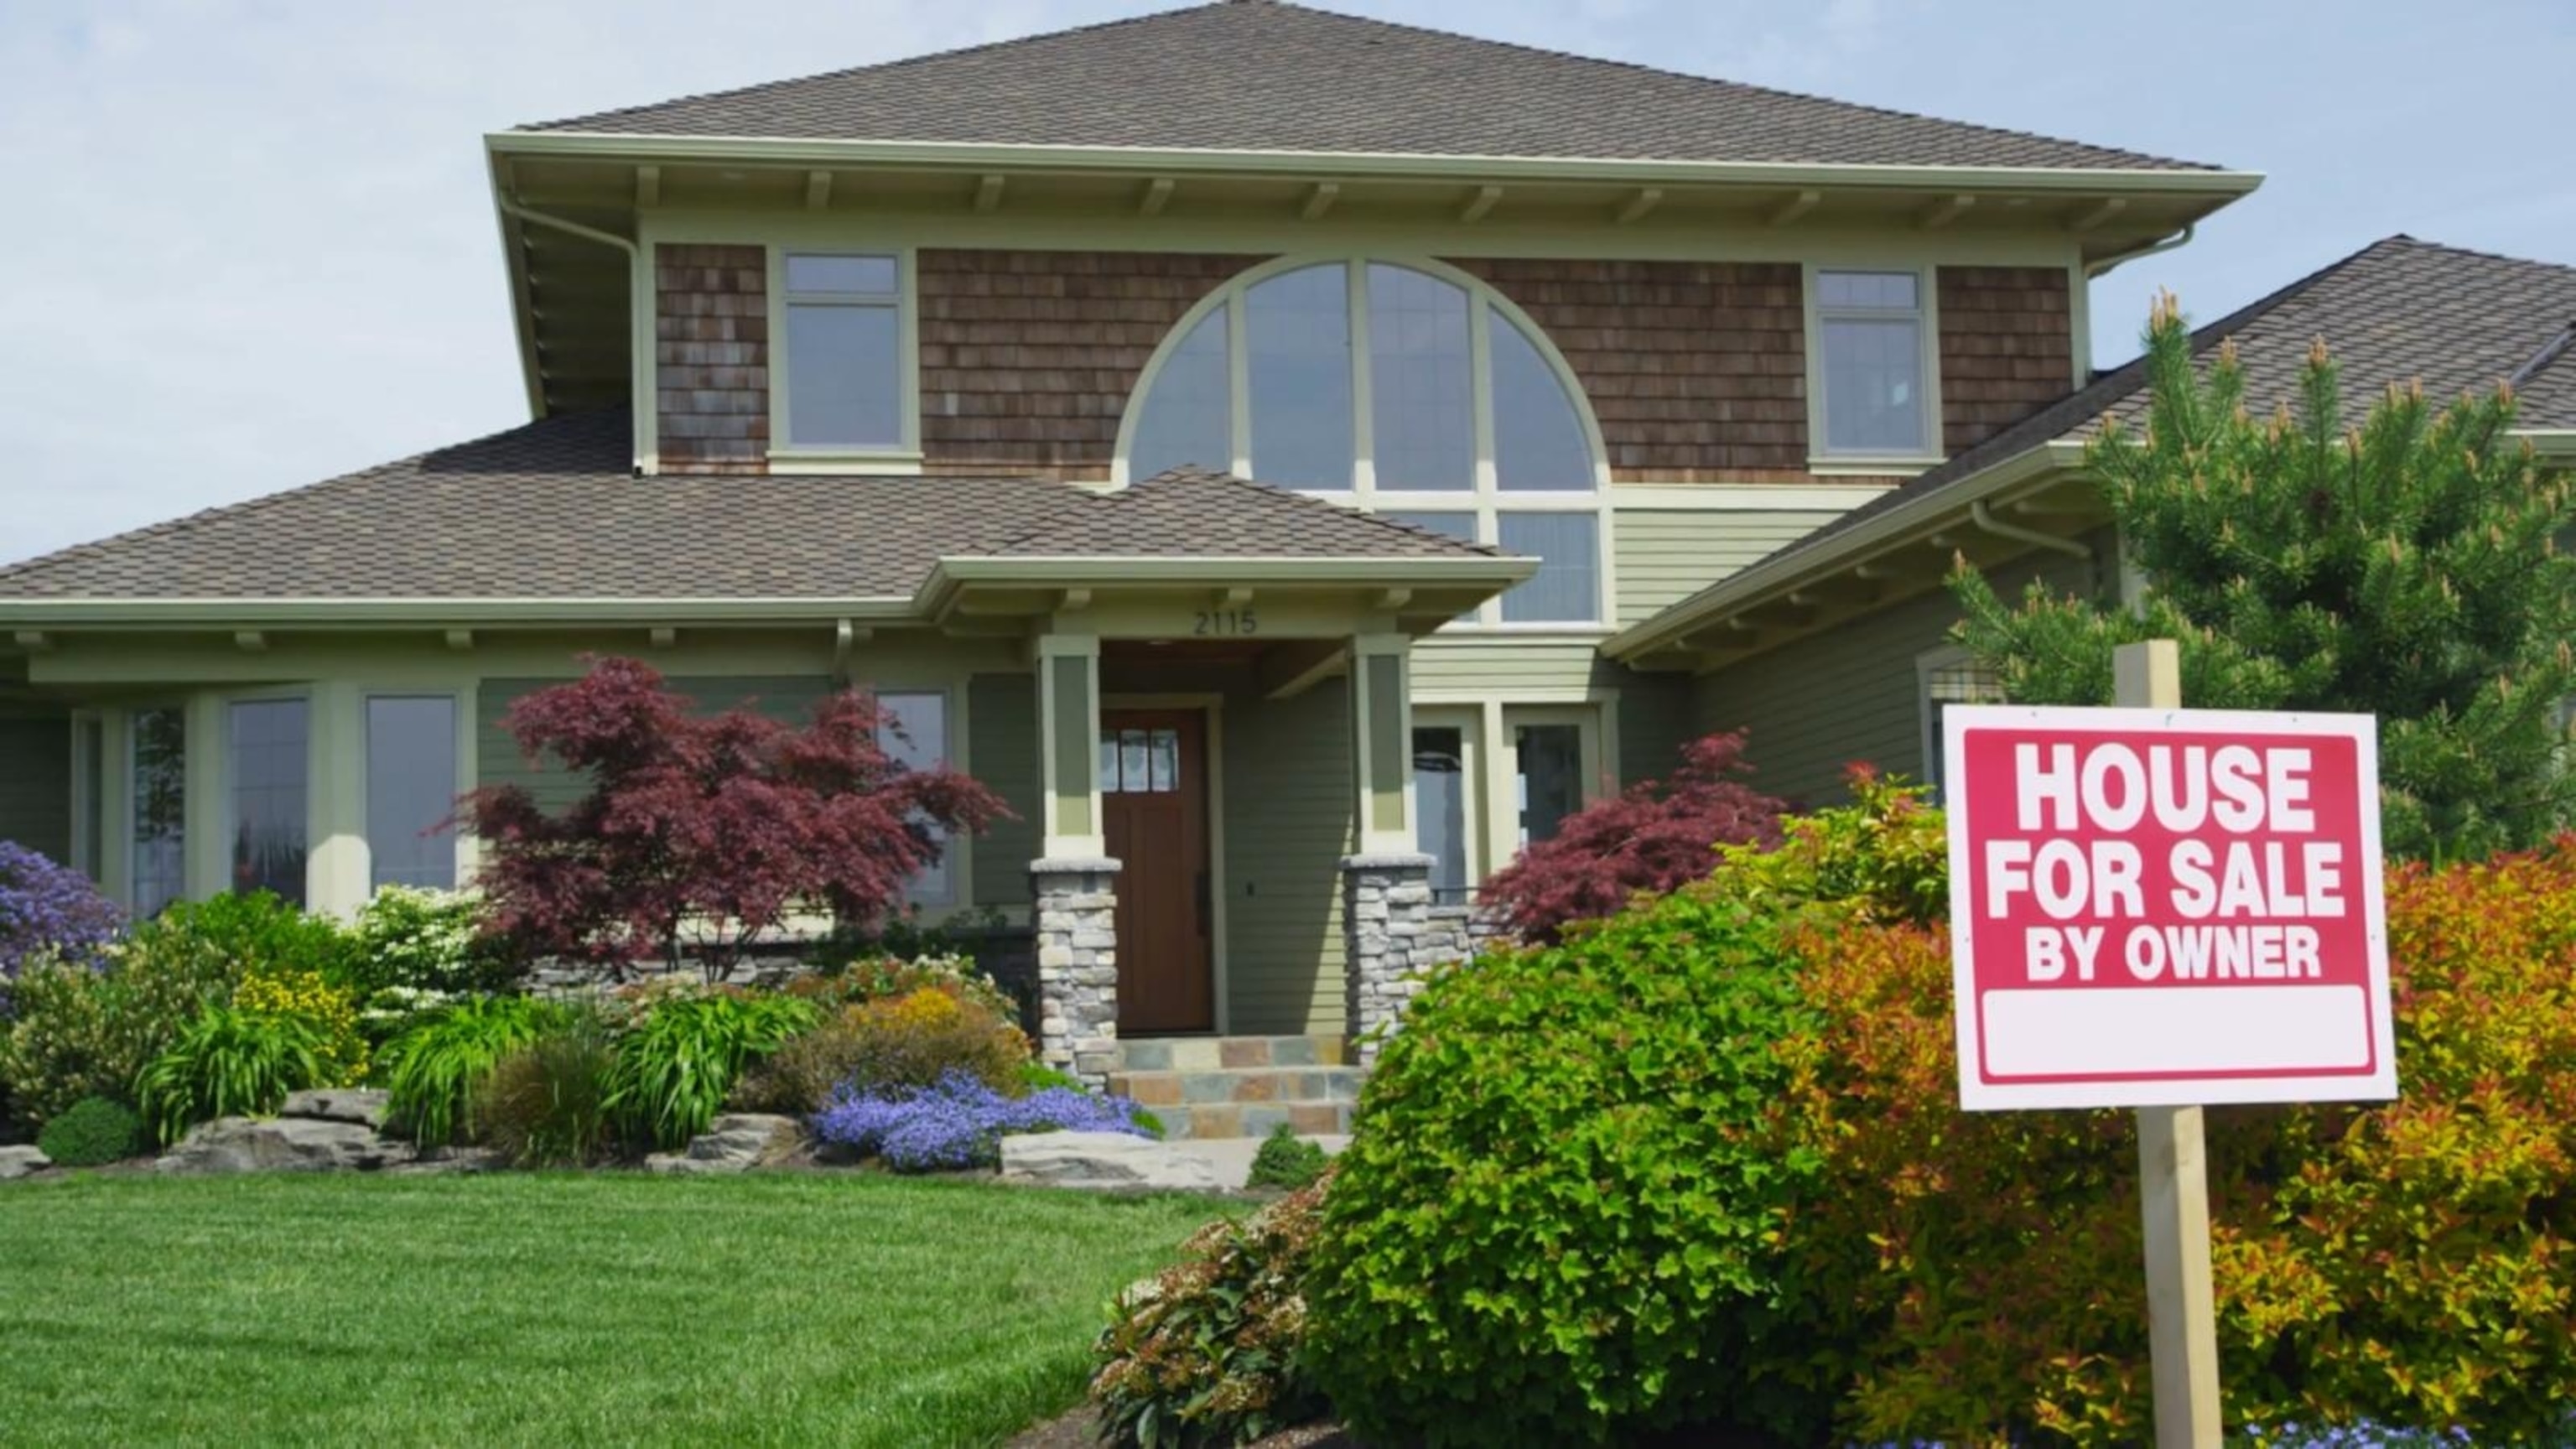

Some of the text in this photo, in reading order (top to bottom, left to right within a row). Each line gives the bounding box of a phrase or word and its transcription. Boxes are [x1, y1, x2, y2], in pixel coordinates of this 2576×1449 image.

[1194, 610, 1257, 635] 2115
[2015, 742, 2315, 833] HOUSE
[1985, 839, 2345, 920] FOR SALE
[2025, 925, 2321, 981] BY OWNER
